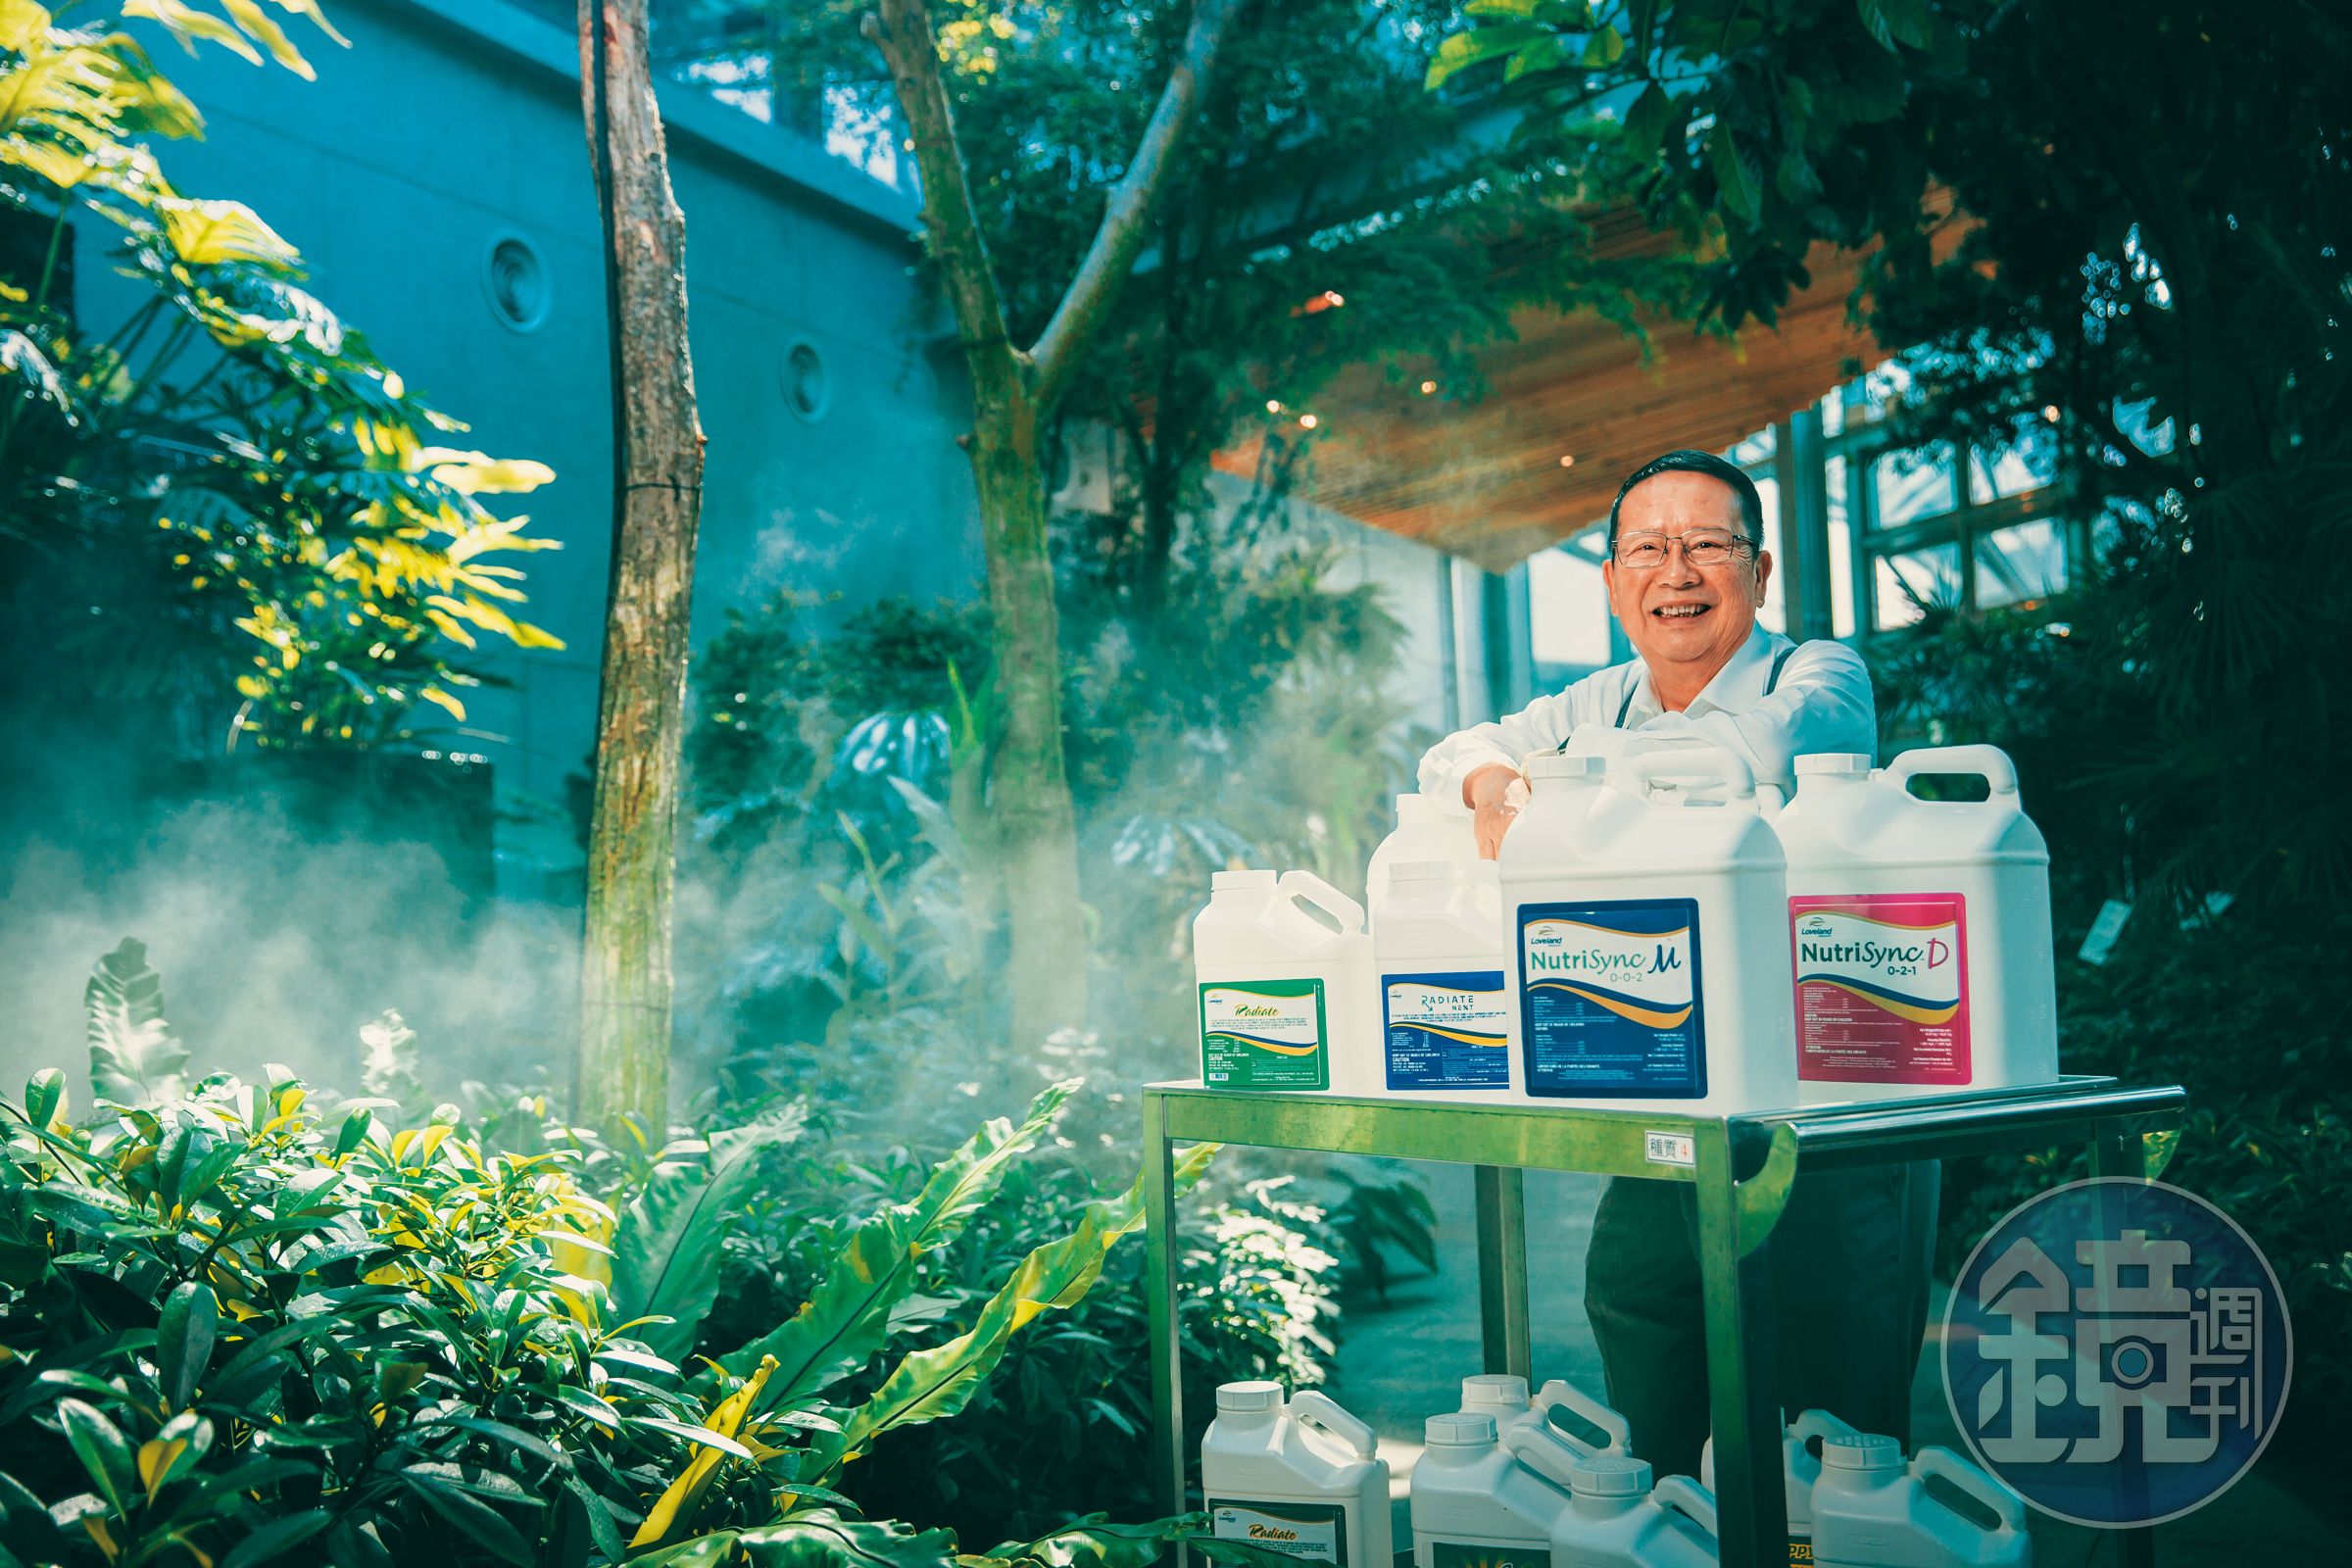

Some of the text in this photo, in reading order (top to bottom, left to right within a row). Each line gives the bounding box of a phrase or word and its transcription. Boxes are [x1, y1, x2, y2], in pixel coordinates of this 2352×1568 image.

[1801, 937, 1949, 969] NutriSync D
[1531, 949, 1646, 975] NutriSync
[1887, 965, 1917, 975] 0-2-1
[1609, 972, 1643, 982] 0-0-2
[1421, 995, 1474, 1004] RADIATE
[1235, 1004, 1279, 1017] Radiate
[1249, 1523, 1298, 1541] Radiate
